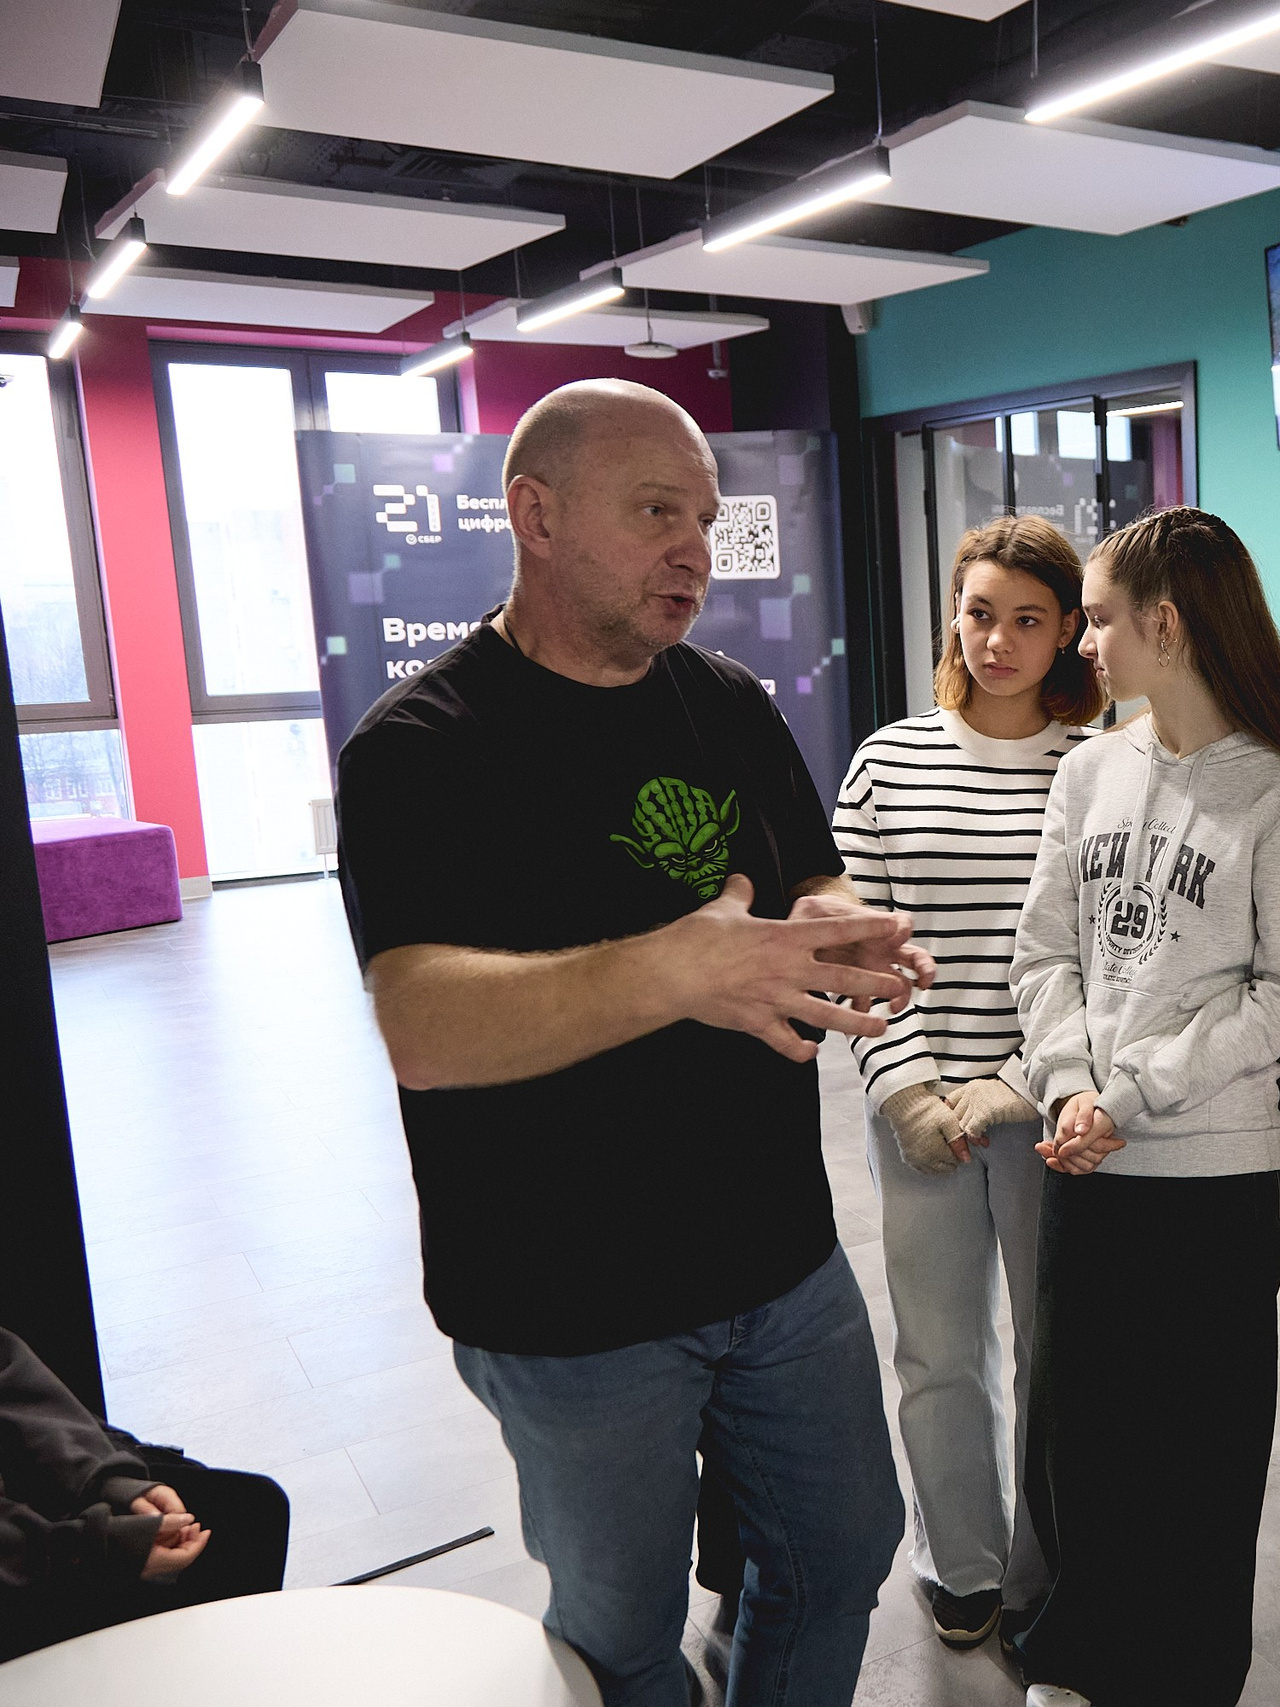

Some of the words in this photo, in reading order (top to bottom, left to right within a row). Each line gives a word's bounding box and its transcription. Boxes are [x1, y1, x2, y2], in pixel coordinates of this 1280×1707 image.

[373, 484, 441, 532] 21
[456, 494, 507, 510] Беспл
[458, 514, 513, 533] цифро
[417, 535, 442, 544] СБЕР
[386, 660, 436, 679] ко
[1144, 834, 1216, 909] YRK
[1110, 900, 1149, 939] 29
